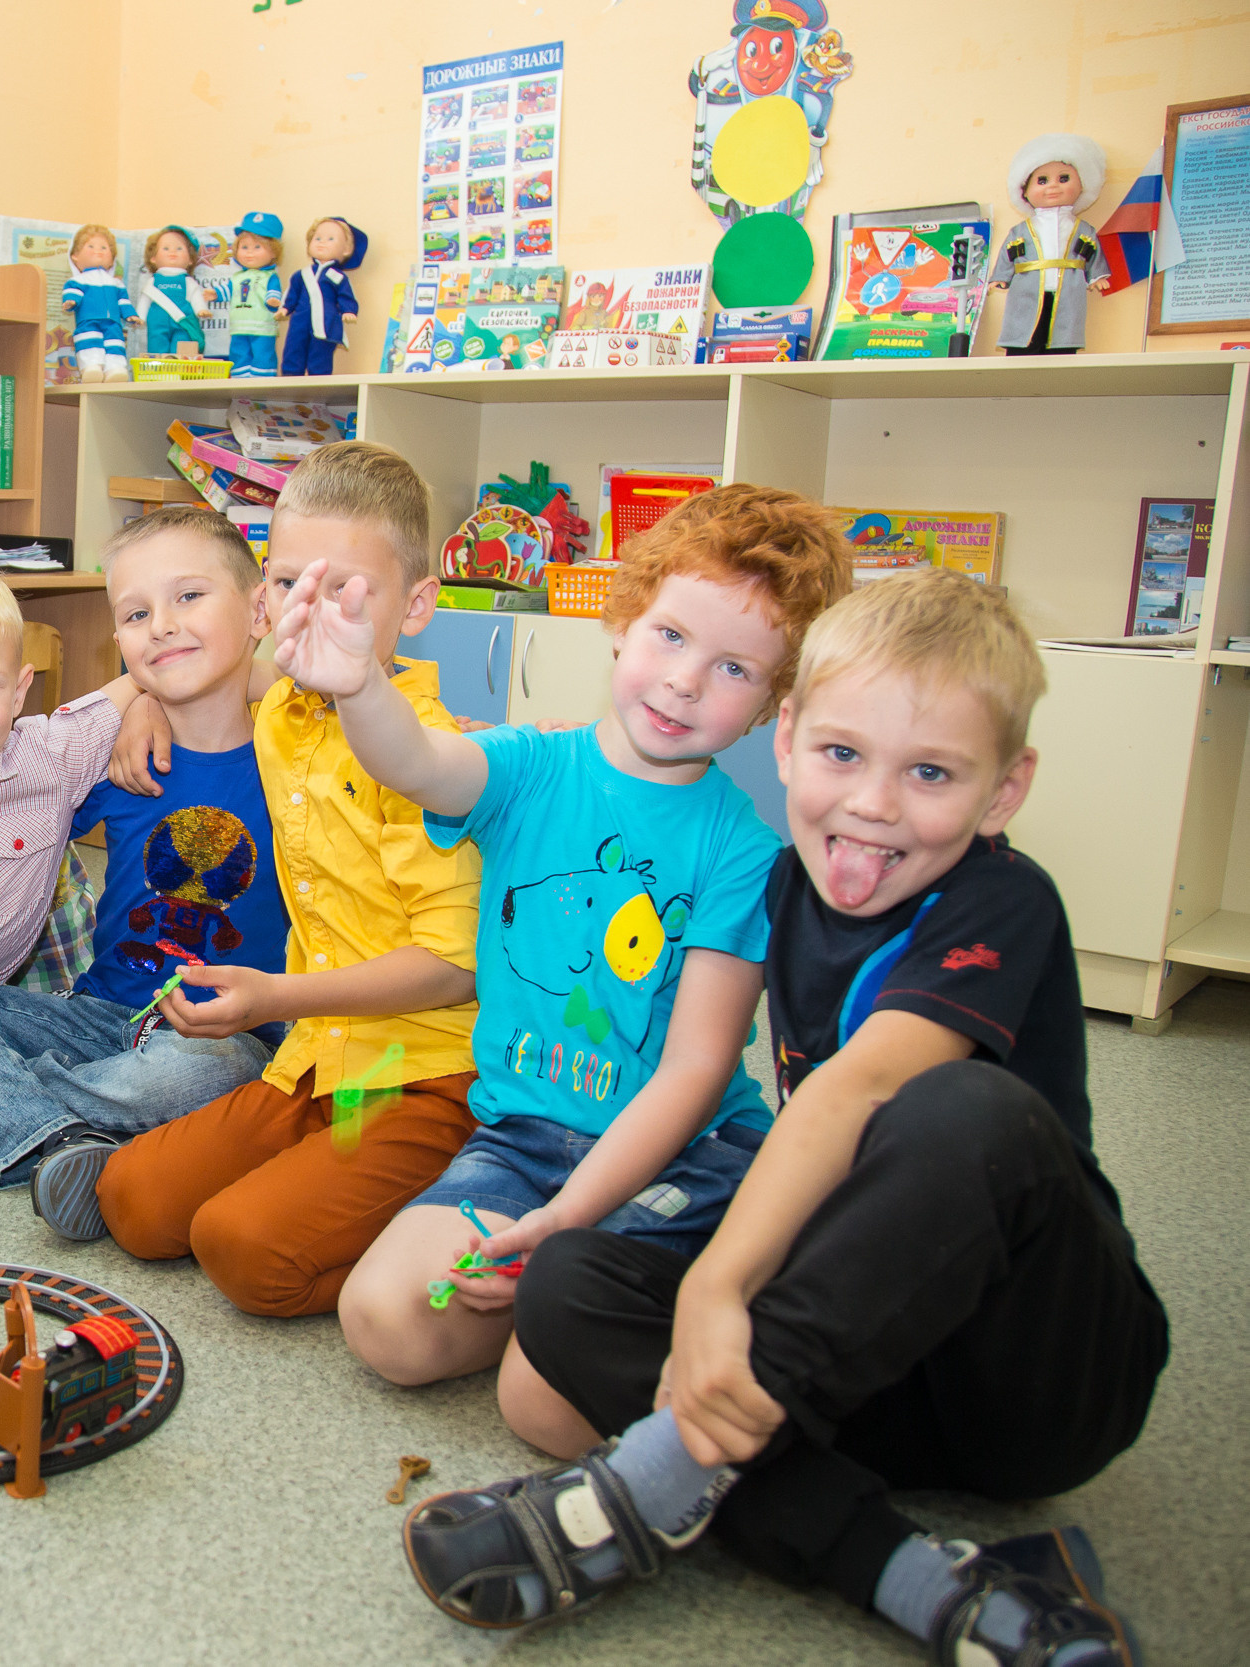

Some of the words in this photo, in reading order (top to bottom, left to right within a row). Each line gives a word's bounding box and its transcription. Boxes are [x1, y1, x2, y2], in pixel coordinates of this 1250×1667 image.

[425, 57, 507, 90] ДОРОЖНЫЕ
[510, 47, 561, 71] ЗНАКИ
[654, 268, 703, 287] ЗНАКИ
[646, 285, 700, 299] ПОЖАРНОЙ
[623, 298, 699, 312] БЕЗОПАСНОСТИ
[480, 318, 540, 326] БЕЗОПАСНОСТИ
[870, 328, 929, 337] РАСКРАСЬ
[867, 338, 924, 347] ПРАВИЛА
[852, 348, 932, 358] ДОРОЖНОГО
[3, 395, 13, 450] РАЗВИВАЮЩИХ
[902, 519, 991, 534] ДОРОЖНЫЕ
[936, 533, 990, 547] ЗНАКИ
[504, 1027, 563, 1084] HELLO
[572, 1050, 622, 1104] BRO!
